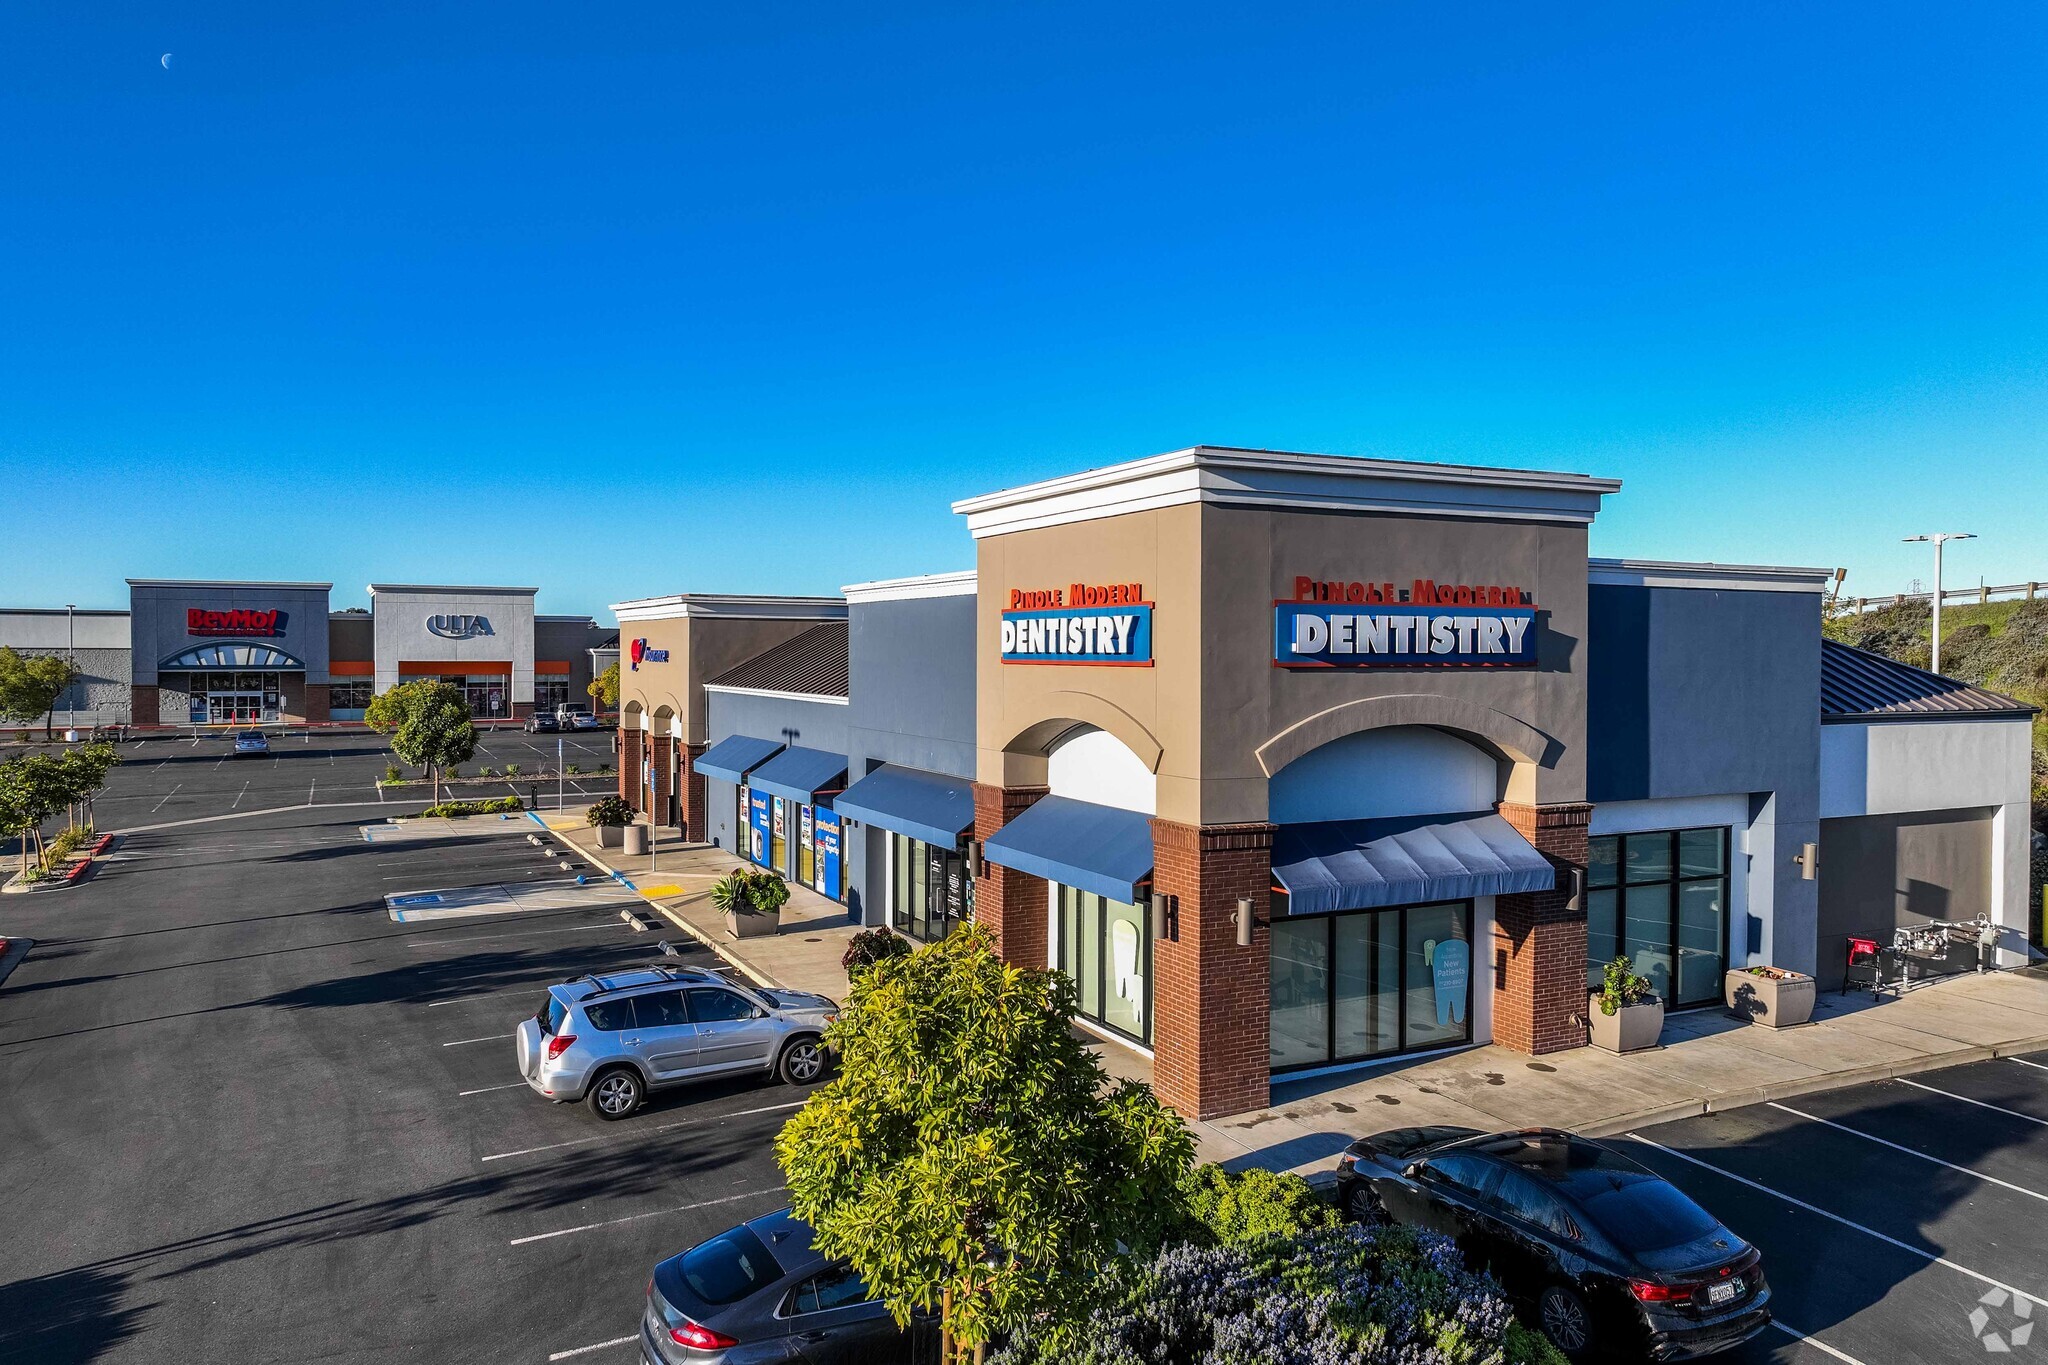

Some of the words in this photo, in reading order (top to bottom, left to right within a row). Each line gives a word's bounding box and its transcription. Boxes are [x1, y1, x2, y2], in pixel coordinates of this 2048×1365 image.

[1011, 589, 1062, 609] PINOLE
[1070, 583, 1142, 606] MODERN
[1296, 576, 1394, 602] PINOLE
[1412, 579, 1521, 605] MODERN
[188, 608, 277, 636] BevMo!
[433, 614, 488, 632] ULTA
[1001, 615, 1133, 653] DENTISTRY
[1296, 614, 1530, 654] DENTISTRY
[1437, 967, 1466, 977] Patients
